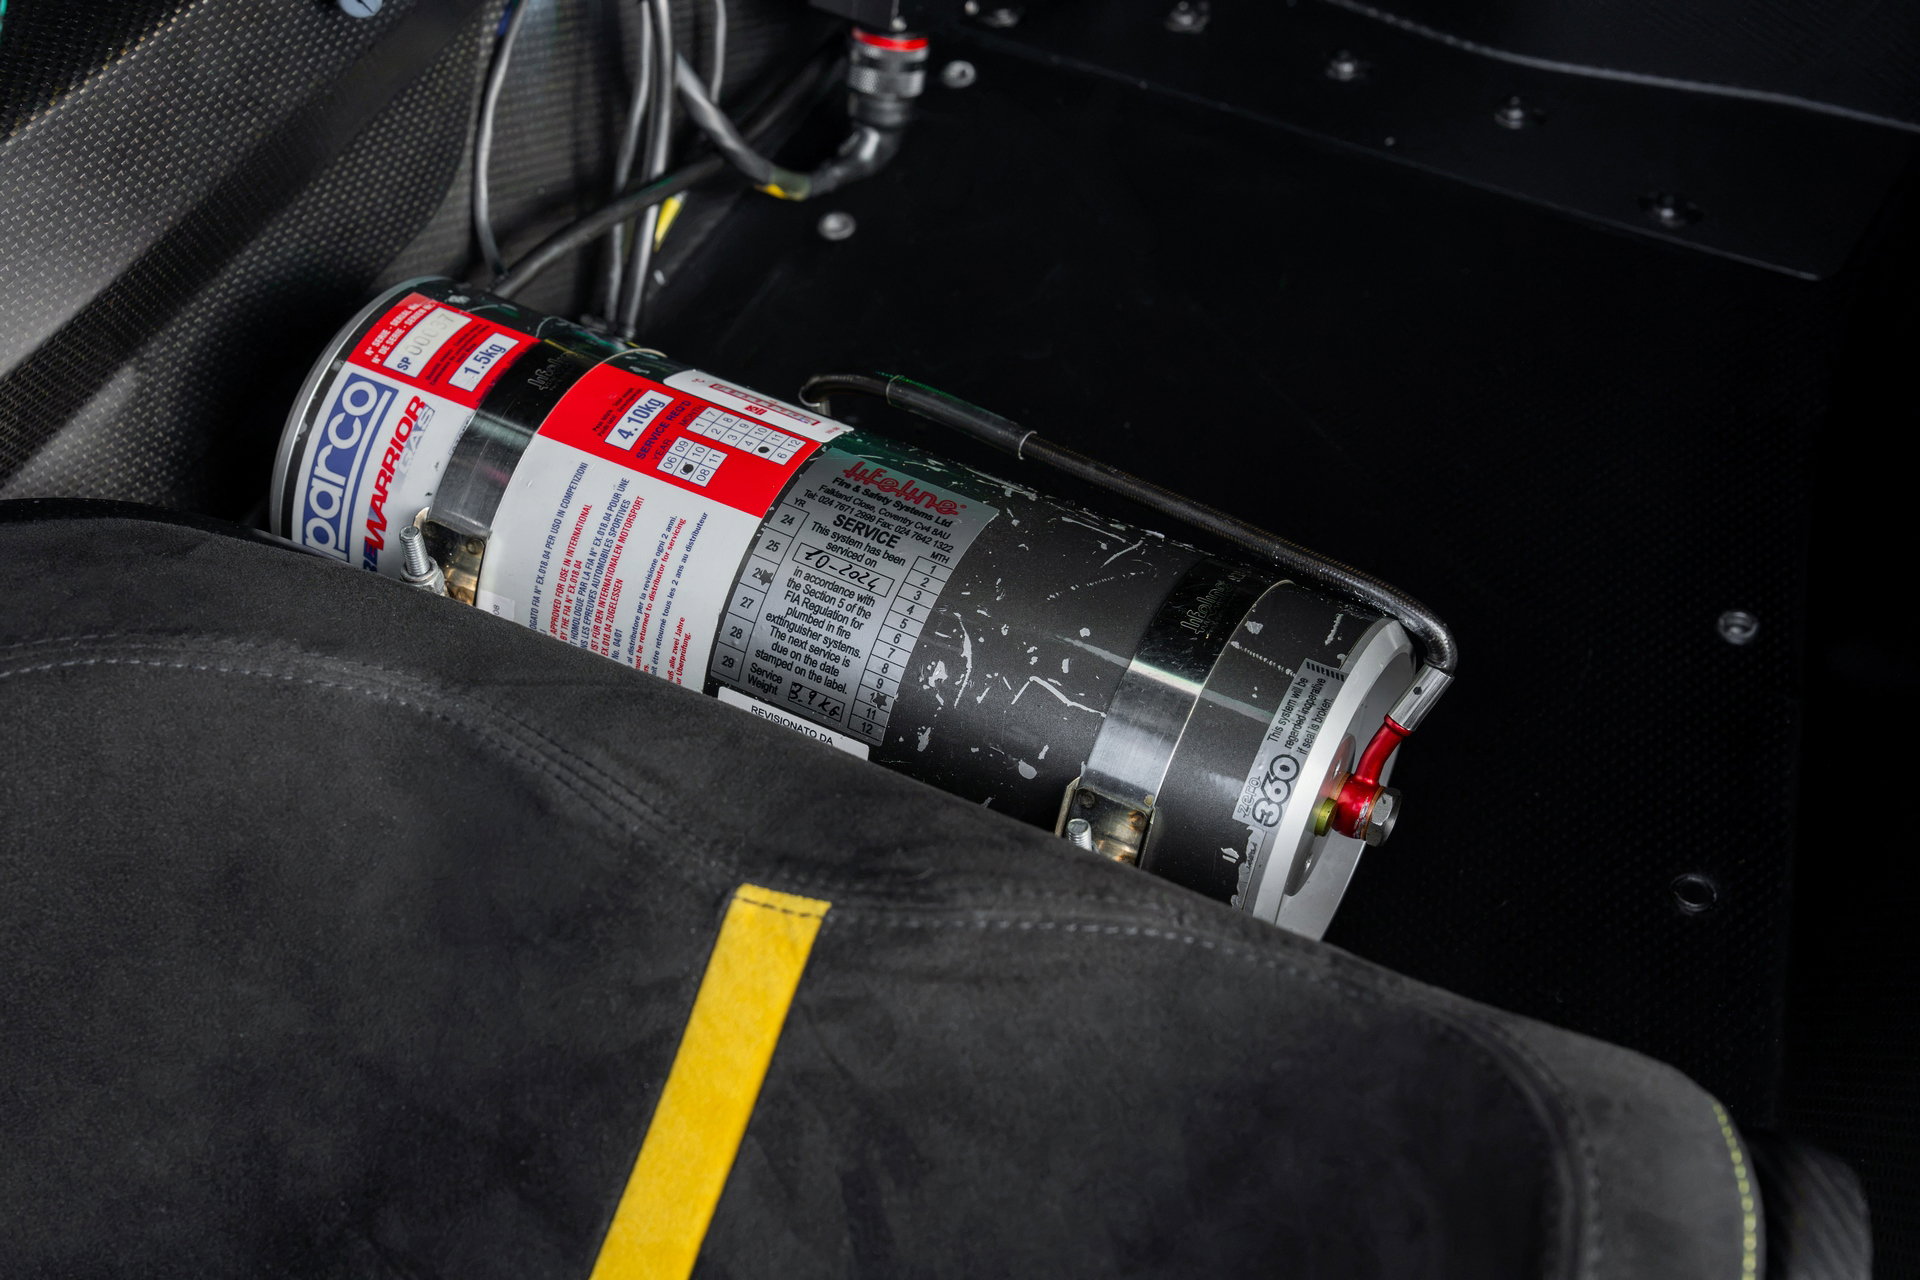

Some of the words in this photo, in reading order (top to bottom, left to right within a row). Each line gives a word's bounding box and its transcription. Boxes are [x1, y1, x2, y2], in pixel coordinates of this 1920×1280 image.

[397, 357, 411, 370] SP
[464, 344, 506, 376] 1.5kg
[617, 398, 666, 440] 4.10kg
[678, 405, 705, 427] MONTH
[636, 421, 671, 460] SERVICE
[652, 438, 673, 460] YEAR
[674, 440, 689, 453] 09
[692, 446, 706, 457] 10
[305, 380, 378, 556] parco
[663, 456, 678, 469] 06
[696, 468, 711, 482] 08
[560, 462, 588, 509] COMPETIZIONI
[616, 478, 629, 492] UNE
[607, 492, 622, 512] POUR
[794, 497, 806, 508] YR
[832, 477, 851, 489] Fire
[861, 488, 892, 506] Safety
[892, 500, 933, 521] Systems
[934, 516, 953, 528] Ltd
[556, 509, 565, 518] IN
[608, 499, 630, 538] SPORTIVES
[617, 496, 644, 544] MOTORSPORT
[780, 514, 795, 526] 24
[804, 489, 817, 500] Tel:
[818, 495, 834, 506] 024
[834, 501, 854, 514] 7671
[854, 509, 876, 523] 2999
[875, 517, 894, 530] Fax:
[894, 525, 911, 536] 024
[910, 531, 932, 545] 7642
[933, 540, 954, 553] 1322
[818, 484, 853, 502] Falkland
[852, 498, 876, 512] Close,
[878, 508, 913, 527] Coventry
[931, 528, 951, 540] 8AU
[550, 518, 562, 534] USO
[566, 504, 592, 557] INTERNATIONAL
[592, 512, 612, 547] EX.018.04
[667, 518, 686, 550] servicing
[833, 514, 901, 549] SERVICE
[545, 534, 556, 549] PER
[765, 539, 781, 552] 25
[811, 521, 830, 536] This
[830, 531, 863, 549] system
[863, 542, 881, 556] has
[882, 549, 905, 566] been
[563, 558, 571, 567] IN
[585, 558, 595, 570] FIA
[591, 538, 614, 589] AUTOMOBILES
[661, 552, 670, 562] for
[825, 542, 865, 563] serviced
[864, 558, 877, 568] on
[930, 551, 950, 564] MTH
[535, 550, 551, 585] EX.018.04
[559, 567, 569, 582] USE
[582, 571, 591, 581] LA
[597, 544, 623, 609] INTERNATIONALEN
[930, 565, 937, 574] 1
[567, 560, 582, 594] EX.018.04
[627, 615, 640, 656] distributore
[643, 558, 658, 591] revisione
[655, 540, 665, 557] ogni
[665, 516, 677, 533] anni.
[648, 563, 665, 602] distributor
[655, 618, 667, 649] retourné
[662, 600, 672, 617] tous
[667, 588, 676, 599] les
[675, 565, 684, 579] ans
[681, 553, 689, 563] au
[685, 512, 708, 552] distributeur
[920, 577, 929, 588] 2
[555, 583, 565, 598] FOR
[577, 581, 588, 597] PAR
[793, 566, 803, 578] in
[803, 572, 855, 599] accordance
[856, 593, 875, 607] with
[913, 590, 922, 601] 3
[531, 596, 540, 607] FIA
[583, 589, 598, 625] EPREUVES
[605, 578, 623, 623] ZUGELESSEN
[645, 603, 652, 611] to
[739, 596, 754, 609] 27
[786, 577, 802, 591] the
[802, 584, 836, 606] Section
[837, 598, 846, 609] 5
[845, 603, 858, 613] of
[856, 605, 871, 620] the
[550, 598, 562, 635] APPROVED
[562, 605, 571, 617] FIA
[570, 596, 584, 640] HOMOLOGUE
[594, 609, 604, 624] DEN
[784, 590, 800, 605] FIA
[801, 597, 849, 625] Regulation
[850, 617, 864, 630] for
[906, 604, 915, 615] 4
[560, 616, 569, 630] THE
[591, 624, 601, 639] FÜR
[639, 612, 650, 643] returned
[675, 617, 685, 637] Jahre
[784, 606, 826, 629] plumbed
[825, 620, 835, 633] in
[836, 625, 851, 640] fire
[899, 618, 908, 629] 5
[559, 630, 567, 641] BY
[581, 626, 590, 639] LES
[600, 623, 612, 656] EX.018.04
[612, 628, 622, 647] 04/01
[729, 626, 743, 639] 28
[893, 633, 902, 644] 6
[590, 639, 599, 652] IST
[611, 649, 620, 660] No.
[636, 645, 643, 654] be
[672, 637, 680, 655] zwei
[770, 625, 787, 641] The
[787, 635, 809, 650] next
[808, 644, 841, 664] service
[841, 655, 851, 668] is
[822, 636, 861, 659] systems.
[887, 647, 896, 659] 7
[721, 655, 735, 668] 29
[771, 641, 788, 656] due
[790, 650, 802, 661] on
[803, 654, 818, 668] the
[819, 661, 839, 677] date
[750, 662, 783, 684] Service
[755, 649, 794, 672] stamped
[794, 666, 806, 677] on
[808, 669, 822, 683] the
[823, 675, 847, 695] label.
[881, 663, 889, 674] 8
[748, 673, 778, 695] Weight
[876, 678, 884, 689] 9
[1295, 677, 1308, 688] be
[1291, 686, 1303, 699] will
[866, 707, 876, 720] 11
[1278, 699, 1297, 726] system
[1284, 714, 1307, 749] regarded
[1299, 678, 1326, 715] inoperative
[1311, 698, 1334, 724] broken.
[751, 705, 817, 739] REVISIONATO
[819, 733, 834, 746] DA
[861, 722, 873, 735] 12
[1266, 726, 1284, 742] This
[1307, 723, 1320, 732] is
[1302, 730, 1316, 749] seal
[1296, 746, 1308, 756] if
[1237, 775, 1261, 818] zero
[1251, 753, 1300, 827] 360
